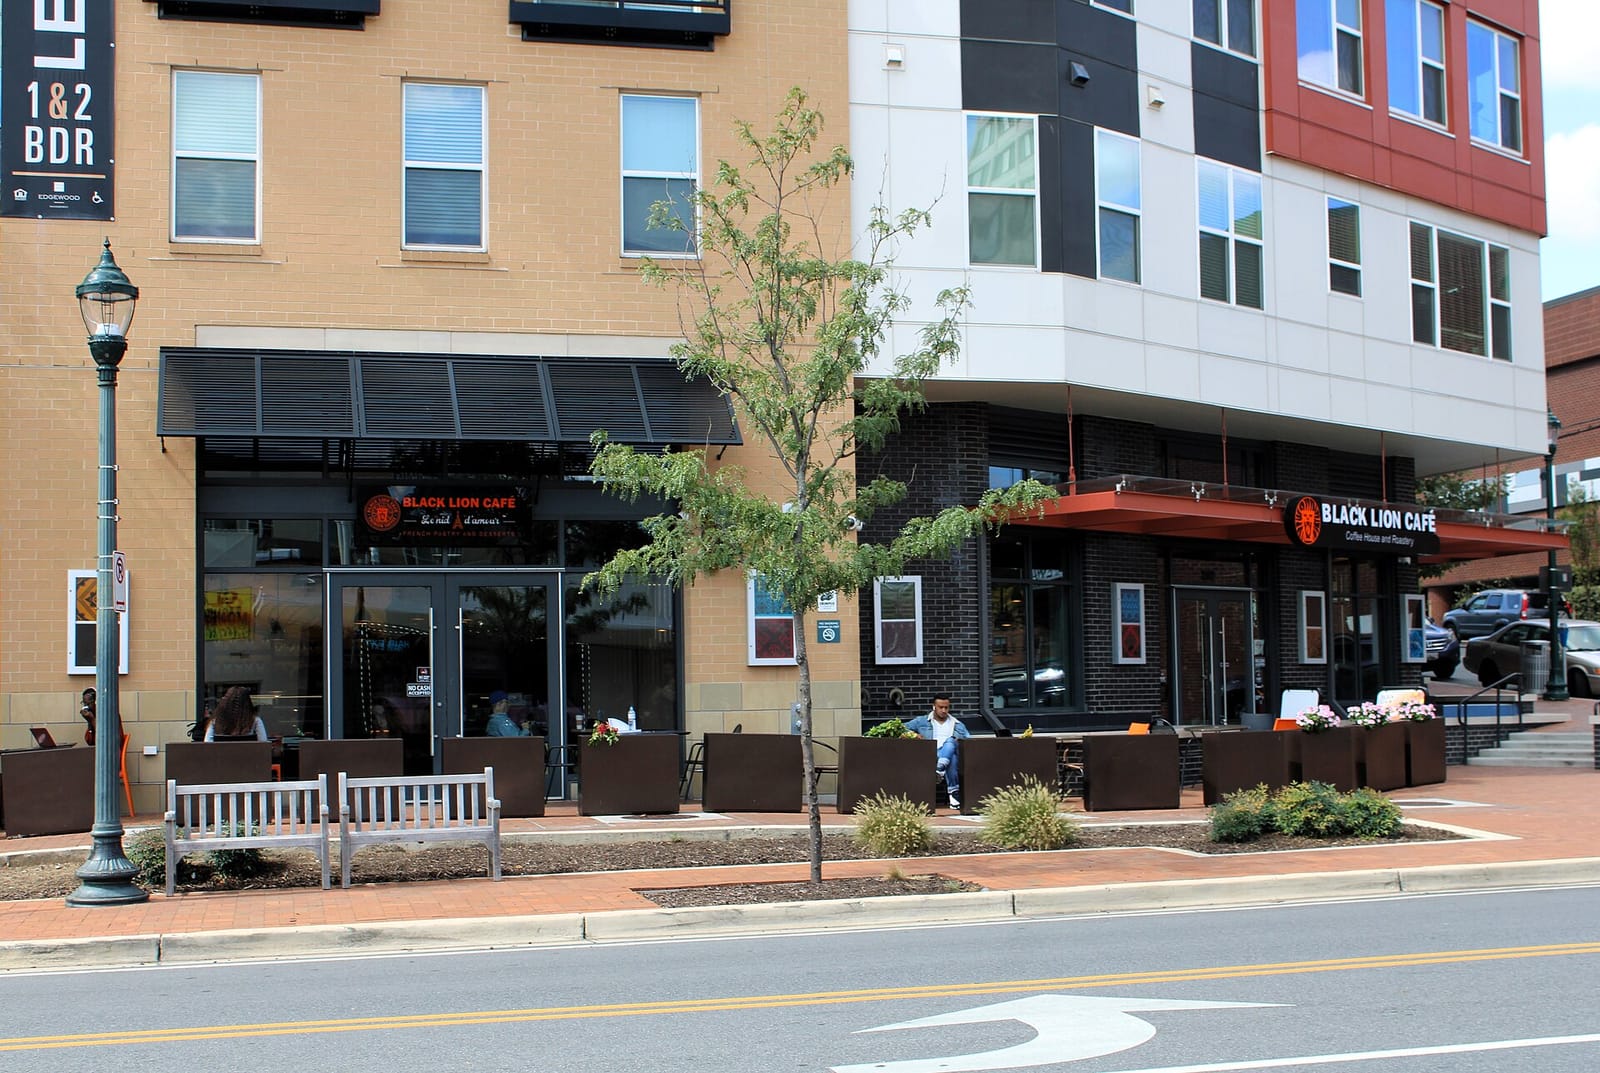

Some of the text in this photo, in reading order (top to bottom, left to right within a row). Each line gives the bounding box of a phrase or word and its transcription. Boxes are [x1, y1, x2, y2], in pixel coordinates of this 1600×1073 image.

[25, 125, 94, 166] BDR
[38, 194, 81, 202] EDGEWOOD
[403, 495, 516, 508] BLACK LION CAFÉ
[1321, 503, 1437, 533] BLACK LION CAFÉ
[1345, 530, 1415, 548] Coffee House and Roastery
